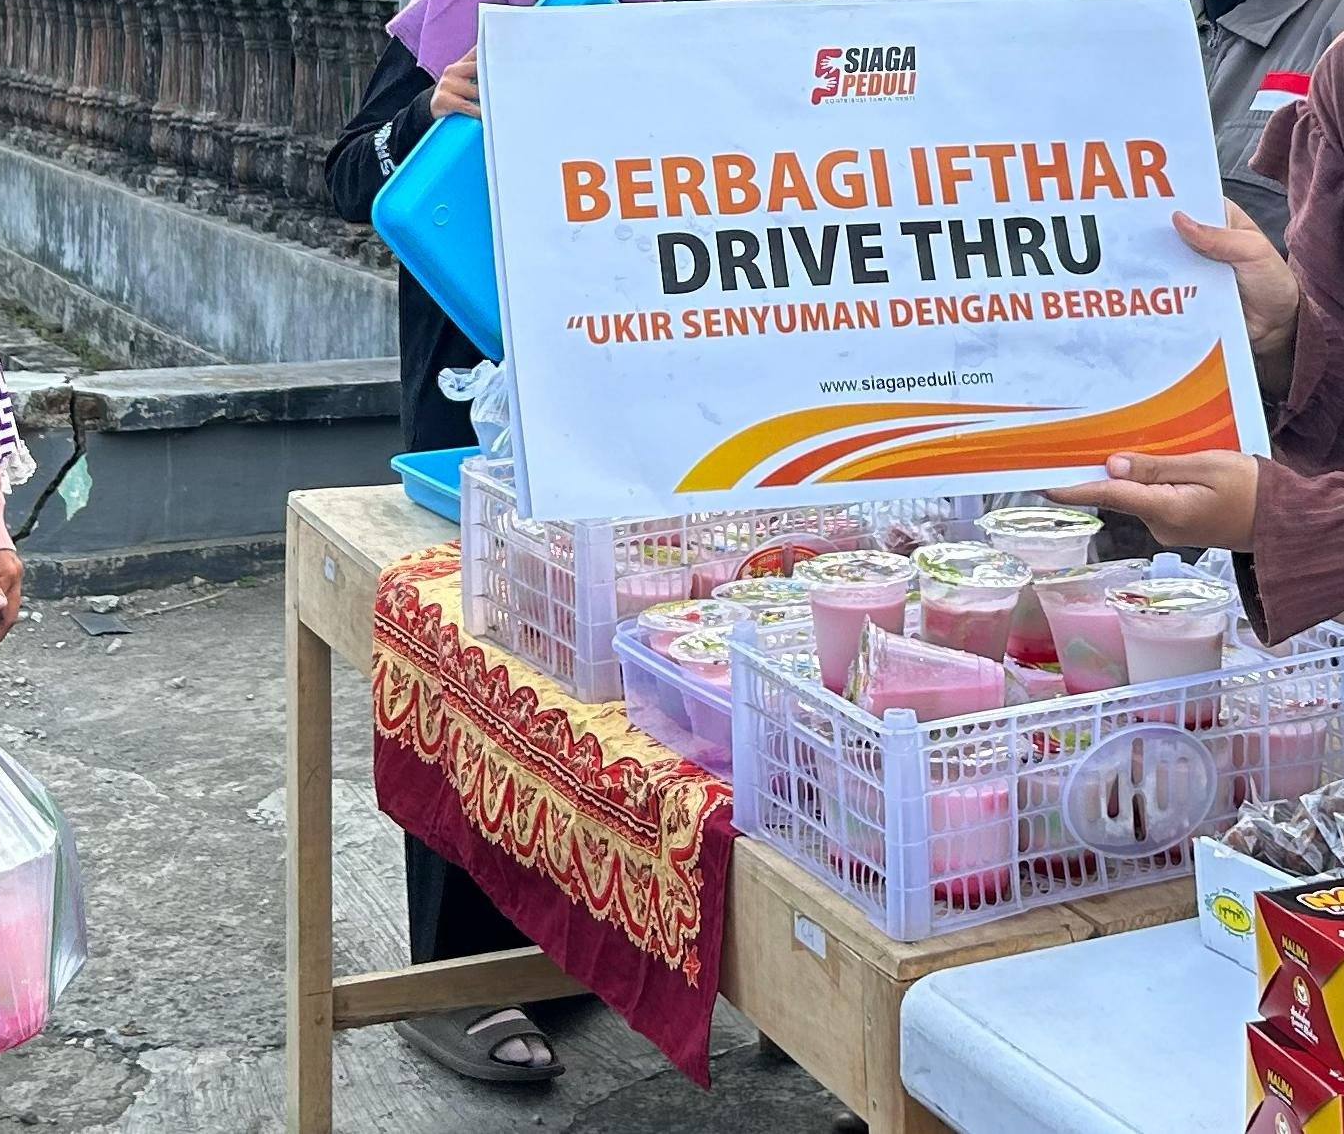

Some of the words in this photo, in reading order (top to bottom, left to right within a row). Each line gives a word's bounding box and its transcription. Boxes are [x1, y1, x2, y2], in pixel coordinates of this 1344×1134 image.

[844, 46, 916, 73] SIAGA
[842, 72, 917, 97] PEDULI
[561, 148, 893, 223] BERBAGI
[908, 139, 1175, 207] IFTHAR
[657, 223, 890, 296] DRIVE
[899, 214, 1103, 282] THRU
[682, 299, 880, 340] SENYUMAN
[889, 292, 1035, 327] DENGAN
[818, 370, 995, 396] www.siagapeduli.com
[1281, 935, 1309, 965] NALINA
[1267, 1069, 1293, 1101] NALINA
